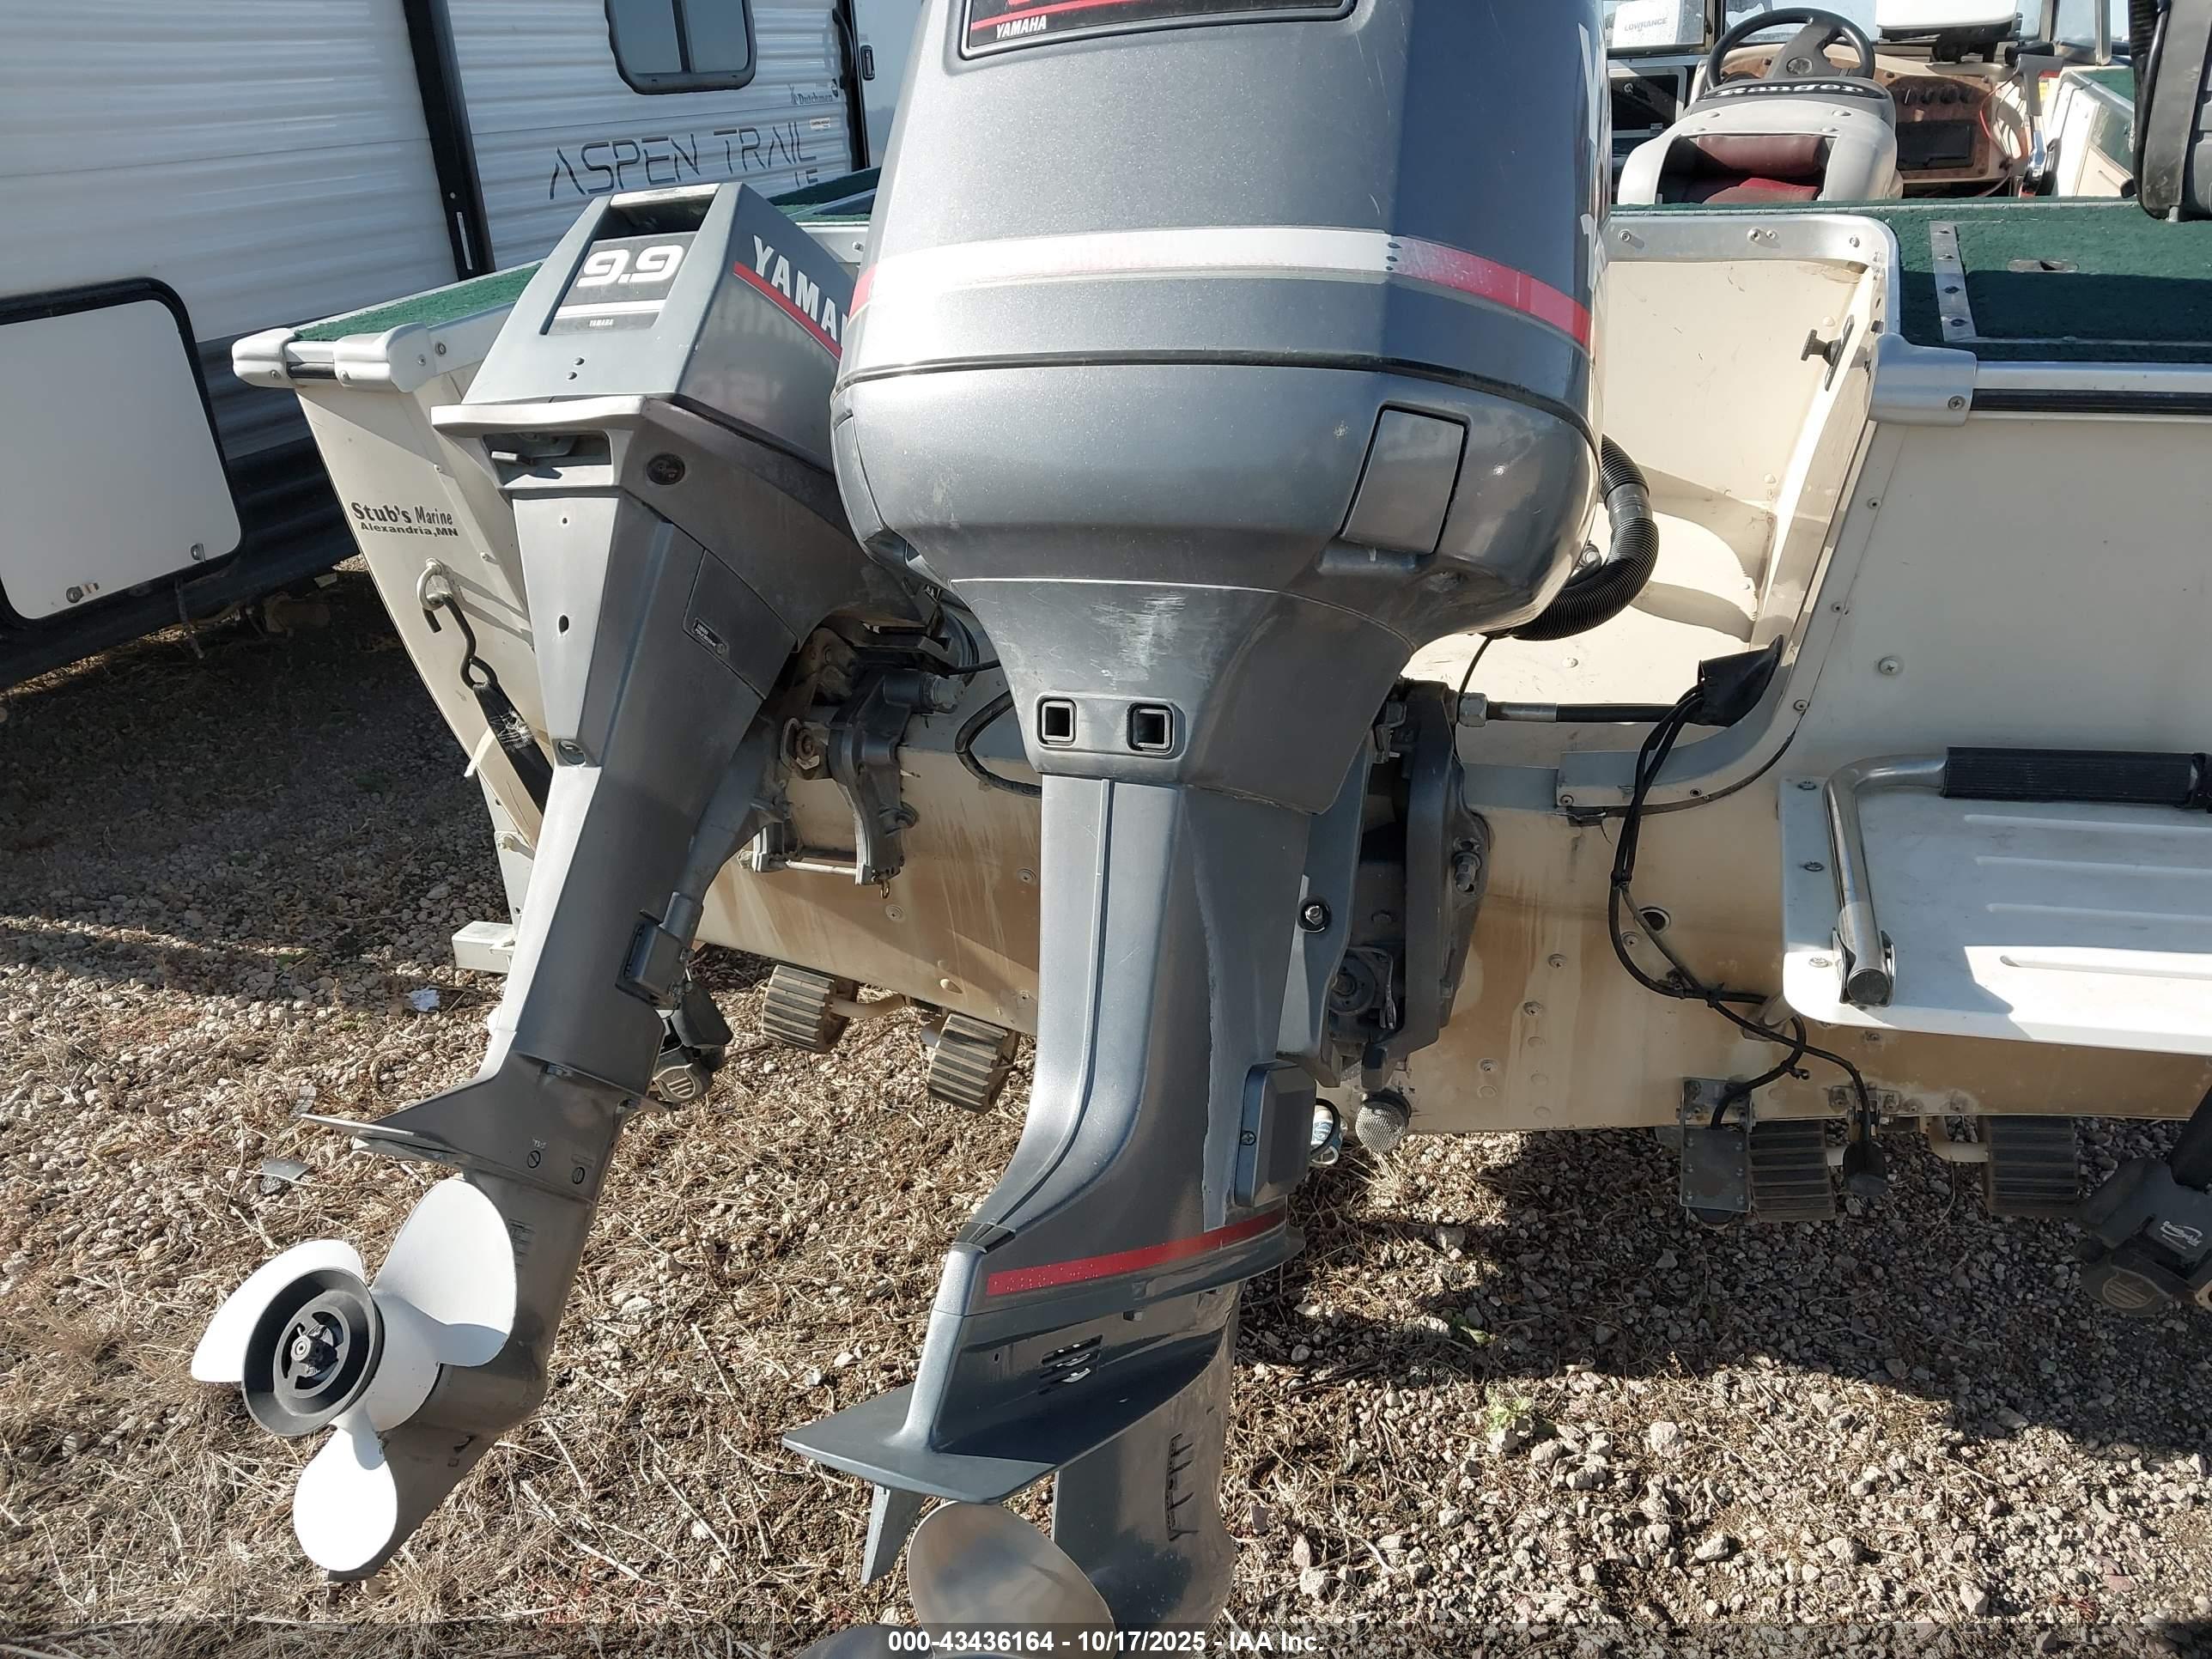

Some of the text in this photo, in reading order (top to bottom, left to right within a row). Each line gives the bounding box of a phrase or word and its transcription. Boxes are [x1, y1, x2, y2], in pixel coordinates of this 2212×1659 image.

[996, 15, 1047, 39] YAMAHA
[1624, 17, 1668, 31] LOWRANCE
[797, 92, 833, 104] Dutchmen
[1716, 83, 1864, 97] Ranger
[550, 121, 817, 199] ASPEN TRAIL
[576, 245, 684, 288] 9.9
[350, 501, 453, 526] Stub's Marine
[361, 521, 459, 538] Alexandria,MN
